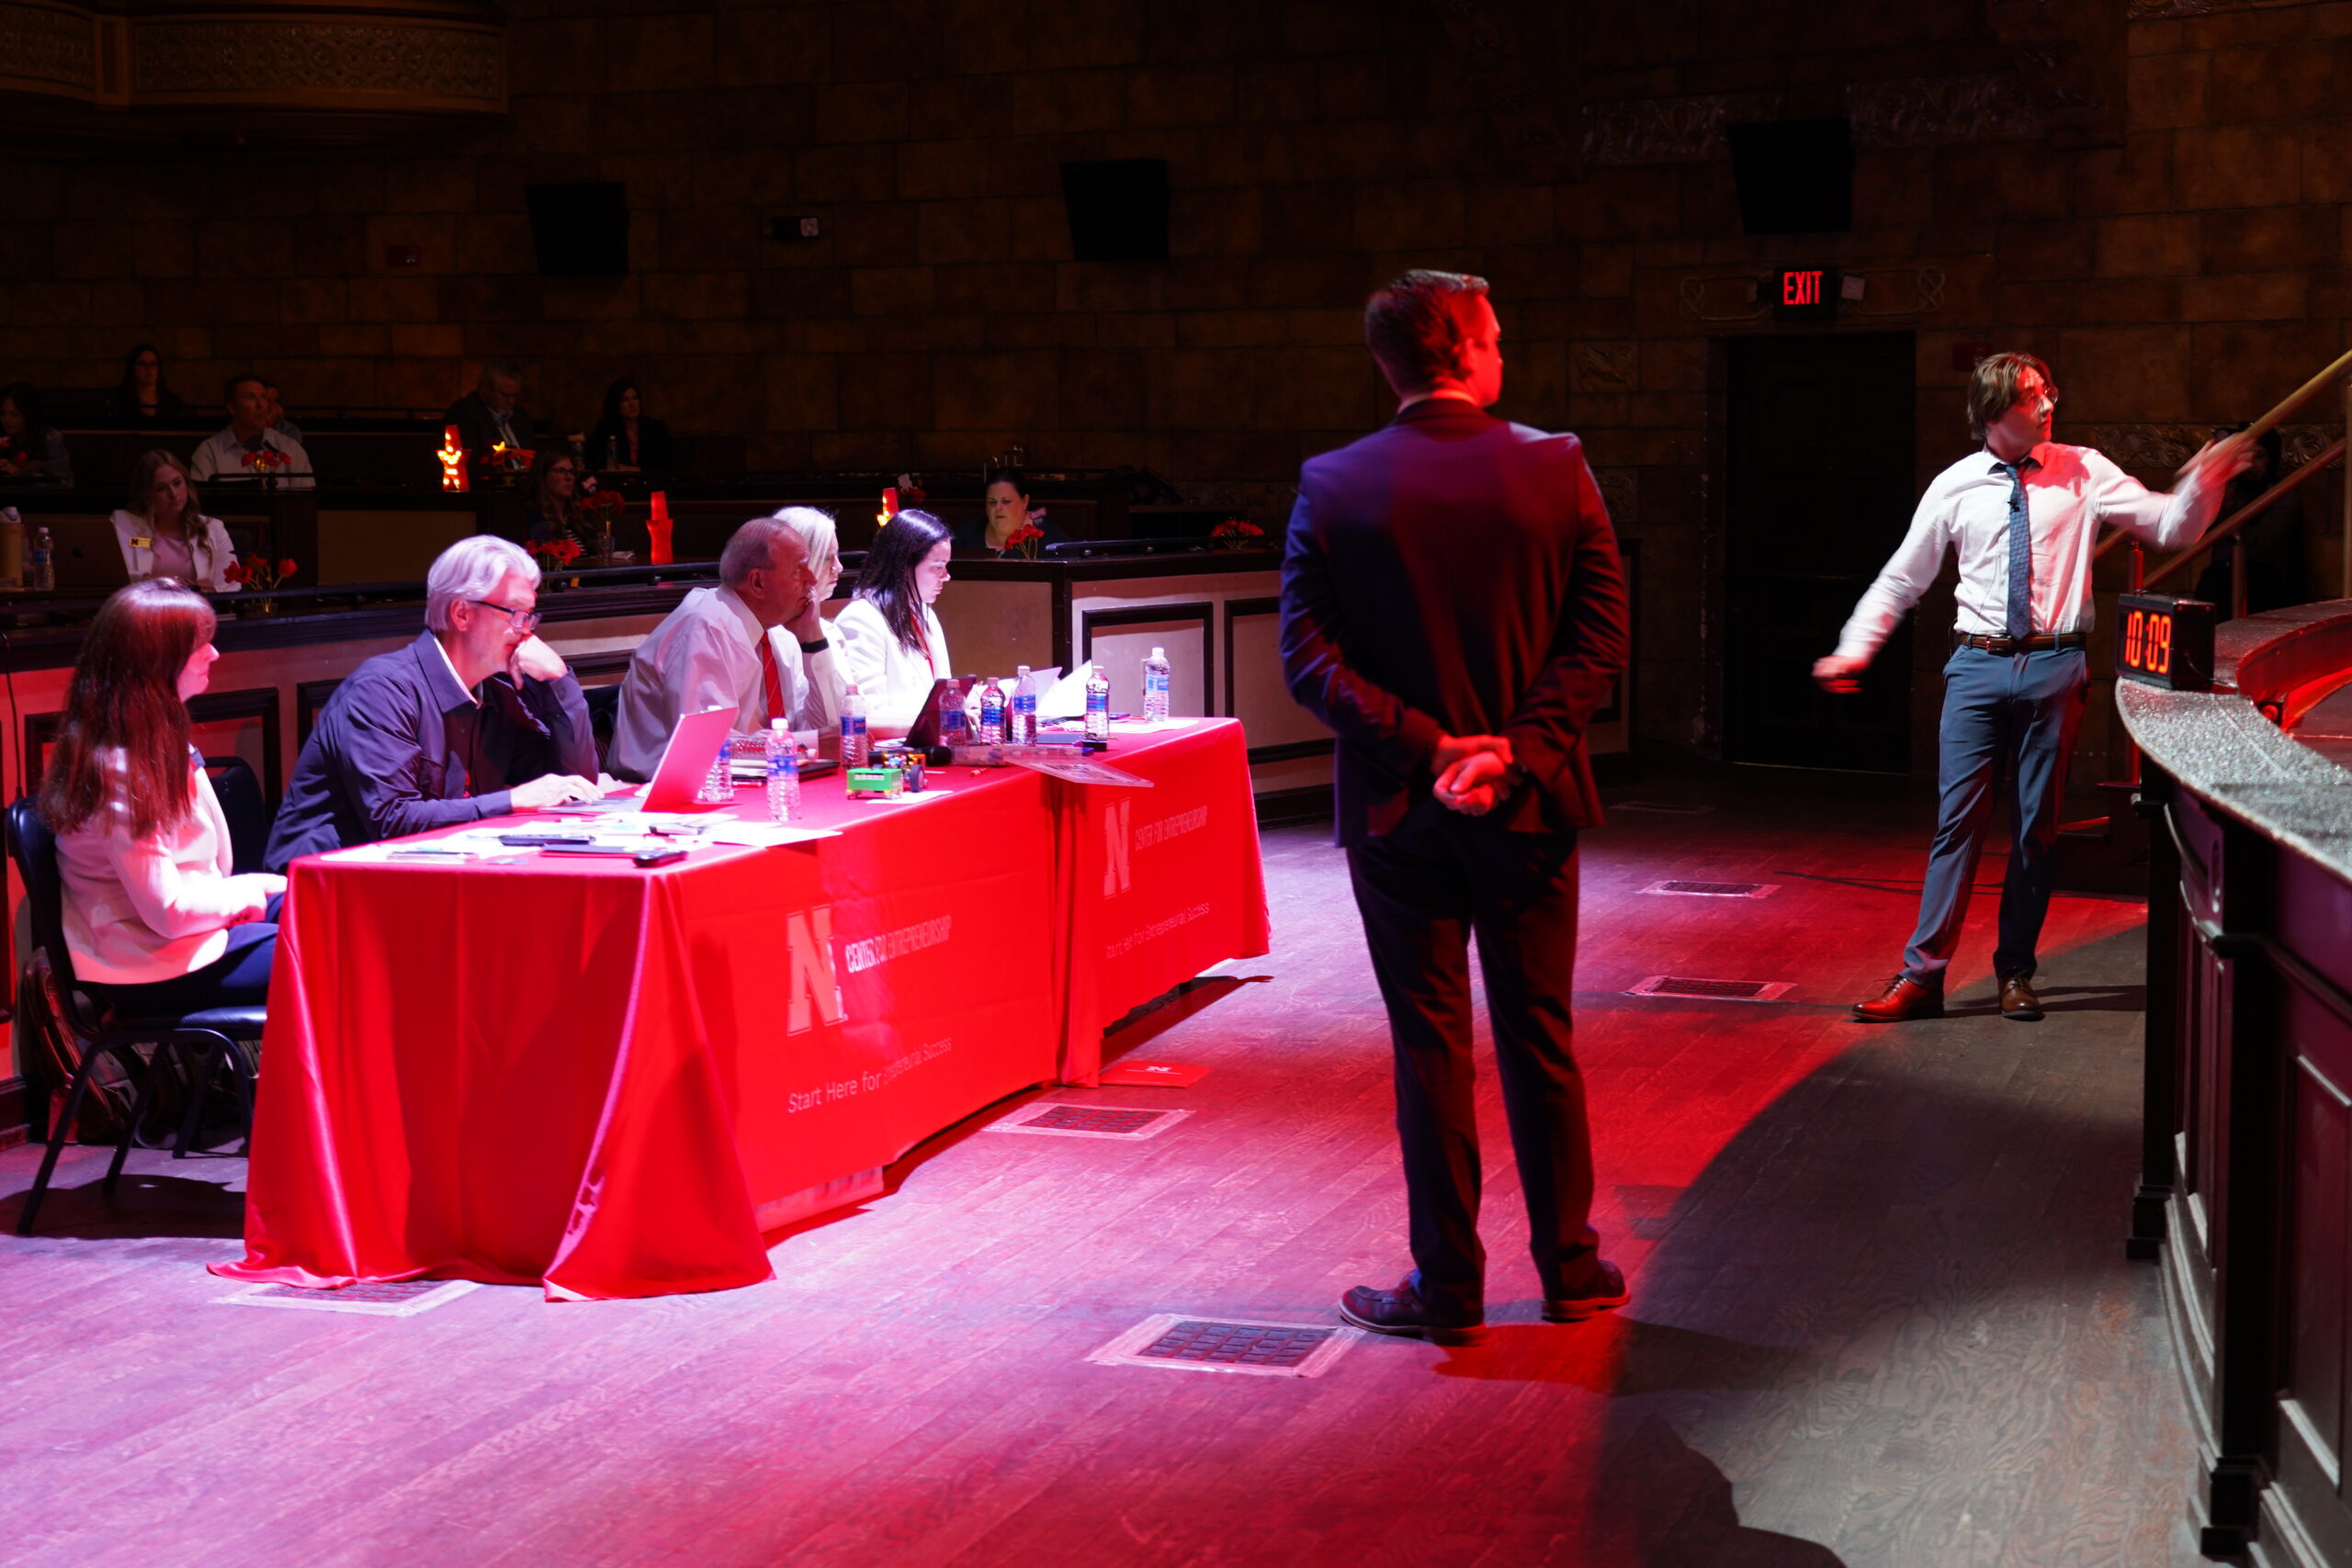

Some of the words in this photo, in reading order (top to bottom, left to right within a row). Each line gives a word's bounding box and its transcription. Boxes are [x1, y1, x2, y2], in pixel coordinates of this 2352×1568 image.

[1783, 271, 1823, 305] EXIT
[2125, 611, 2171, 674] 10:09
[1103, 796, 1131, 900] N
[786, 903, 848, 1037] N
[844, 937, 876, 974] CENTER
[787, 1087, 822, 1113] Start
[826, 1080, 857, 1101] Here
[862, 1070, 882, 1092] for
